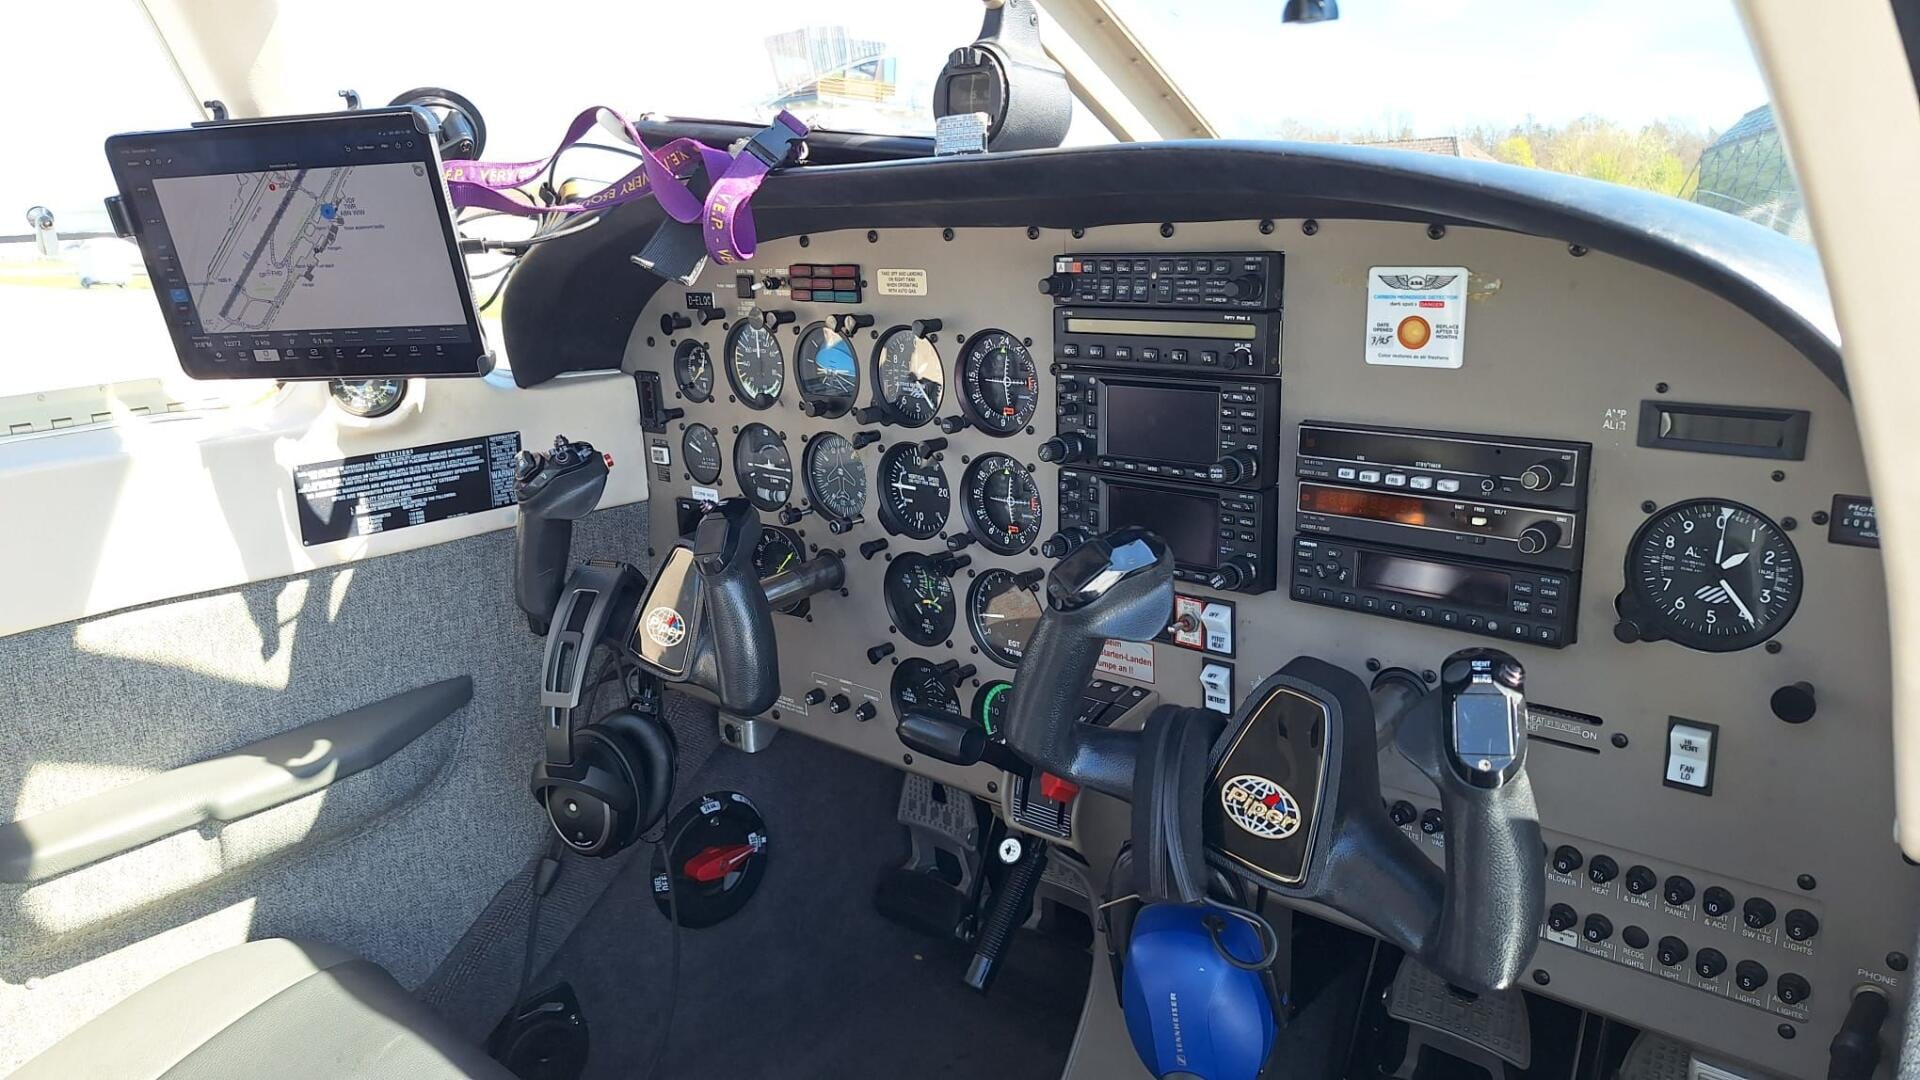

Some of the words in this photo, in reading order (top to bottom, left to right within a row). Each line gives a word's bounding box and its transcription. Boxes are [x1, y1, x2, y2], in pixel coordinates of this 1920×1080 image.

[983, 338, 993, 349] 21
[1000, 336, 1010, 345] 24
[972, 351, 982, 362] 18
[968, 371, 976, 383] 15
[973, 394, 980, 405] 12
[913, 456, 921, 465] 10
[988, 460, 998, 469] 21
[1004, 458, 1014, 467] 24
[977, 470, 987, 481] 18
[938, 488, 948, 498] 20
[973, 489, 981, 499] 15
[915, 512, 924, 520] 10
[1683, 520, 1694, 533] 9
[1716, 516, 1726, 529] 0
[1665, 536, 1675, 548] 8
[1763, 551, 1776, 565] 2
[1662, 578, 1672, 591] 7
[1759, 590, 1771, 603] 3
[1675, 597, 1685, 609] 6
[1706, 610, 1716, 623] 5
[1211, 641, 1224, 649] HEAT
[1097, 661, 1117, 671] umpe
[1118, 664, 1128, 672] an
[1207, 695, 1226, 704] DETECT
[991, 707, 999, 715] 10
[1581, 730, 1597, 740] ON
[1680, 744, 1698, 753] VENT
[1680, 764, 1694, 774] FAN
[1680, 773, 1691, 781] LO
[1226, 786, 1297, 828] Piper
[1424, 822, 1433, 831] 20
[1432, 839, 1444, 847] VAC
[1558, 861, 1566, 869] 10
[1548, 873, 1577, 887] BLOWER
[1591, 886, 1609, 896] HEAT
[1633, 882, 1639, 890] 5
[1671, 893, 1677, 901] 5
[1631, 898, 1651, 908] BANK
[1709, 903, 1718, 912] 10
[1664, 907, 1687, 919] PANEL
[1712, 921, 1728, 930] ACC
[1589, 930, 1597, 938] 10
[1742, 929, 1755, 938] SW
[1757, 933, 1772, 944] LTS
[1794, 928, 1801, 936] 5
[1585, 945, 1609, 958] LIGHTS
[1623, 947, 1645, 959] RECOG
[1783, 941, 1814, 956] LIGHTS
[1664, 954, 1670, 962] 5
[1621, 957, 1645, 970] LIGHTS
[1659, 968, 1681, 980] LIGHT
[1703, 965, 1709, 974] 5
[1857, 968, 1897, 986] PHONE
[1698, 982, 1719, 992] LIGHT
[1743, 978, 1750, 987] 5
[1735, 993, 1761, 1006] LIGHTS
[1786, 991, 1792, 999] 5
[1776, 1007, 1804, 1020] LIGHTS
[1170, 992, 1184, 1053] SENNHEISER
